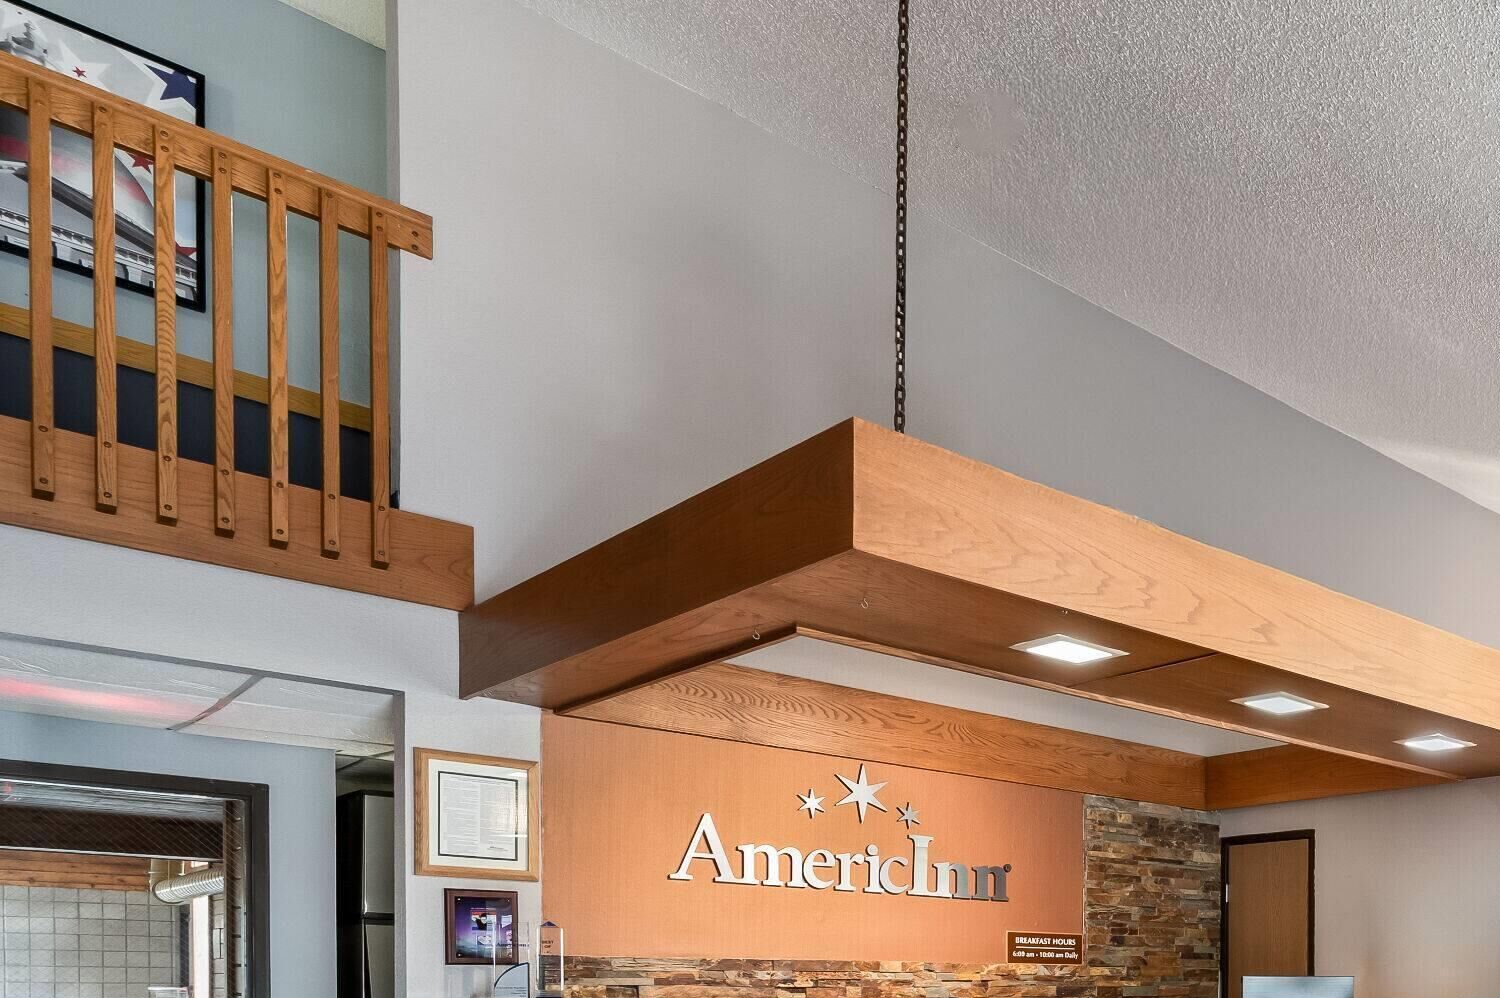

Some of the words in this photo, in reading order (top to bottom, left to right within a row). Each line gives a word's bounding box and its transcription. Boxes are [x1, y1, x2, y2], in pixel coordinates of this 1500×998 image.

[668, 812, 1009, 902] AmericInn
[1015, 936, 1051, 944] BREAKFAST
[1052, 938, 1076, 946] HOURS
[1064, 952, 1079, 960] Daily
